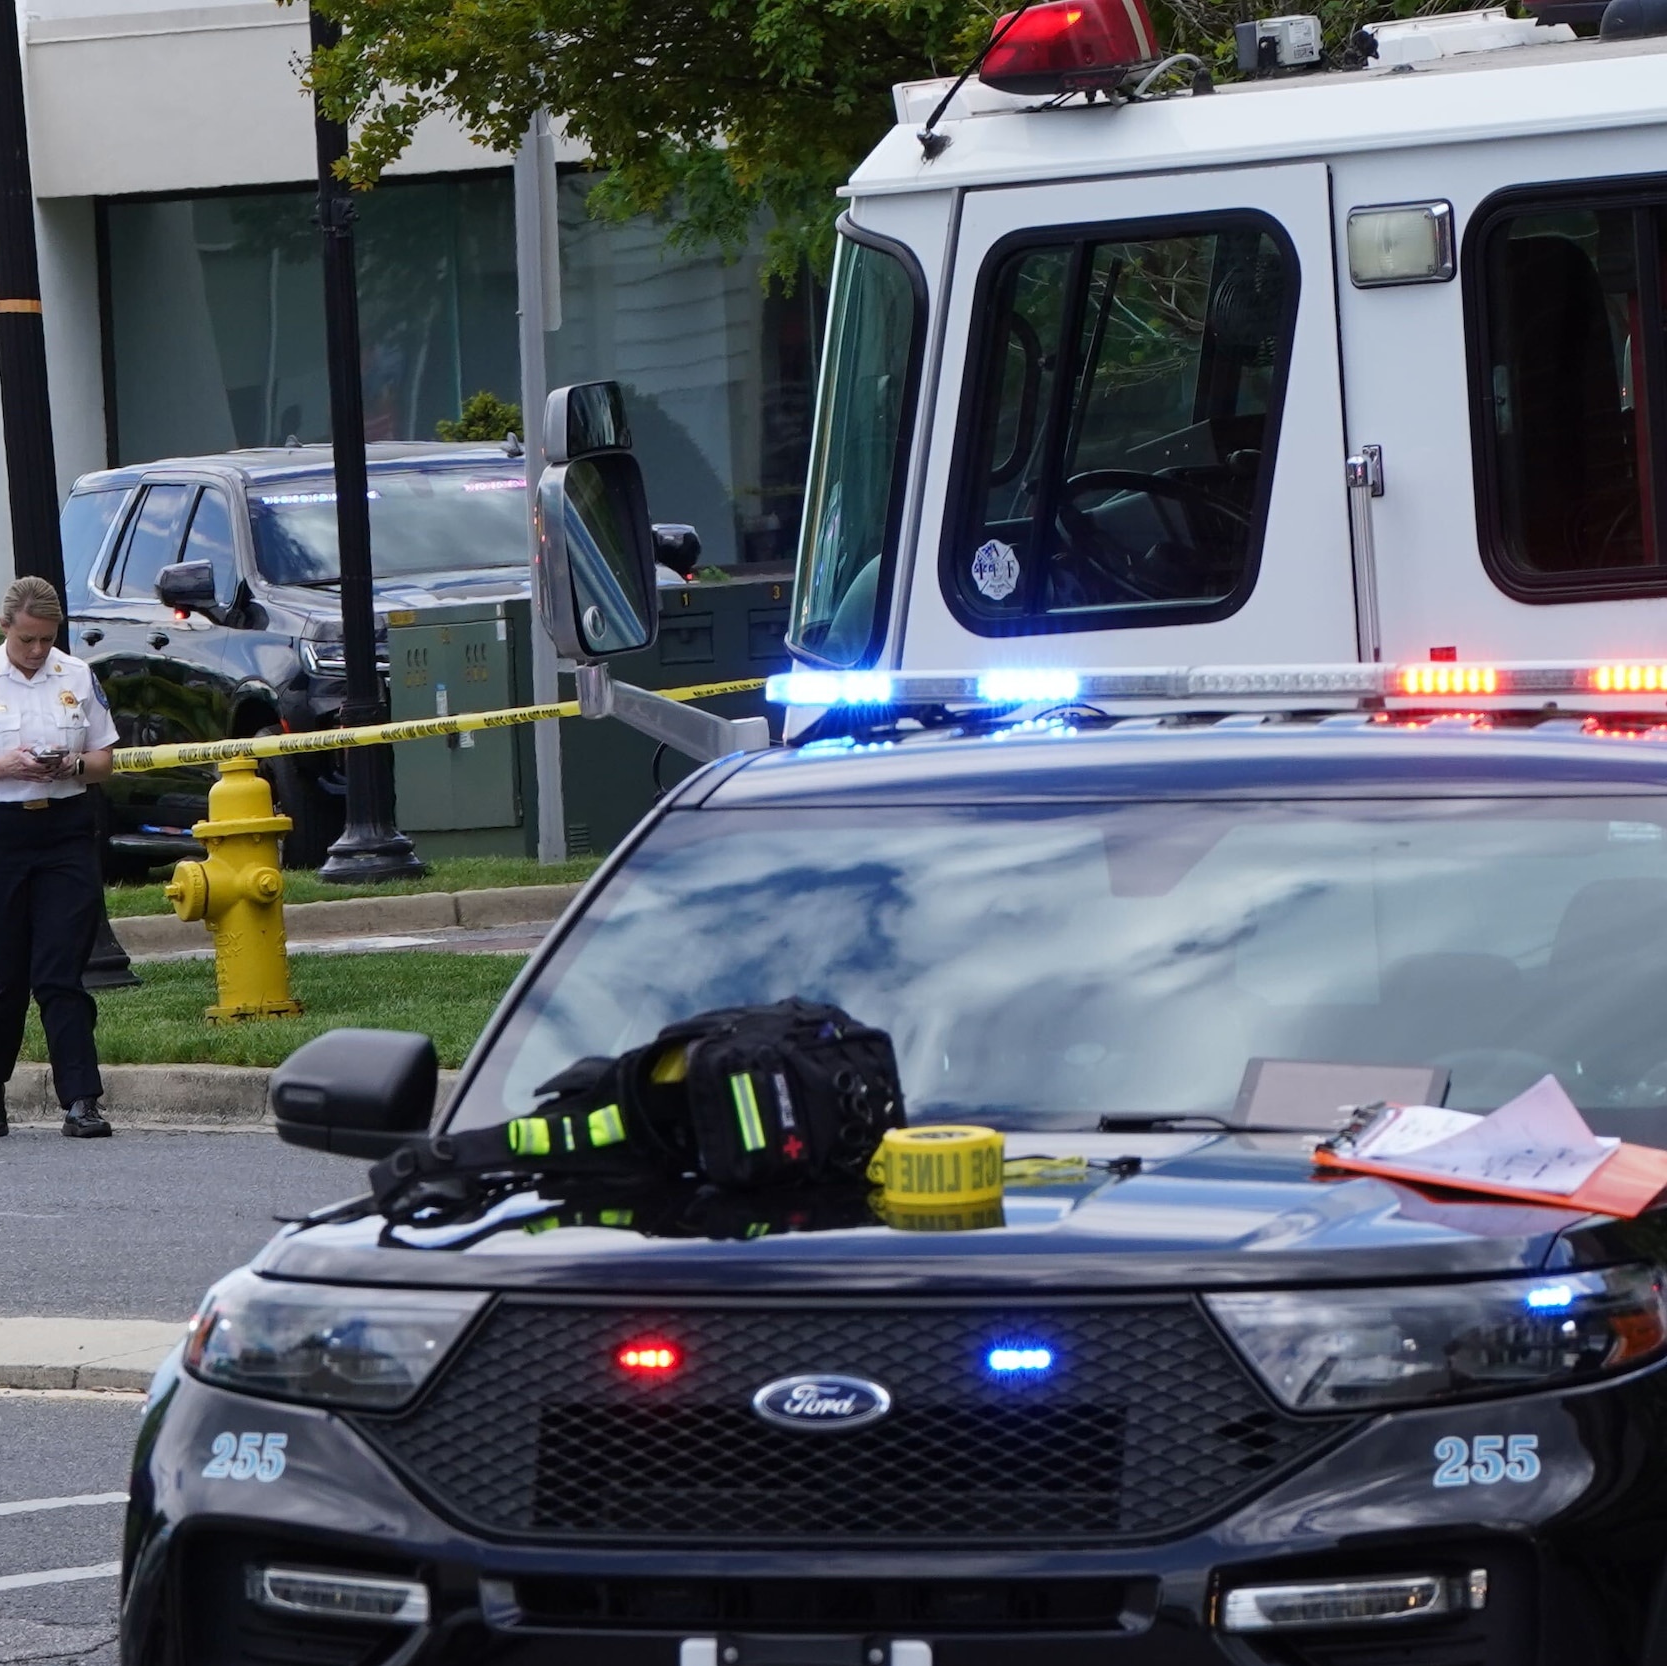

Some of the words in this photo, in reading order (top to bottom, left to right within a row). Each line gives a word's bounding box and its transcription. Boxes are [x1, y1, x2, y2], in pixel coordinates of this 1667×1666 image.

[682, 592, 689, 606] 1
[772, 584, 781, 600] 3
[783, 1384, 858, 1416] Ford
[201, 1431, 289, 1483] 255
[1432, 1433, 1542, 1489] 255
